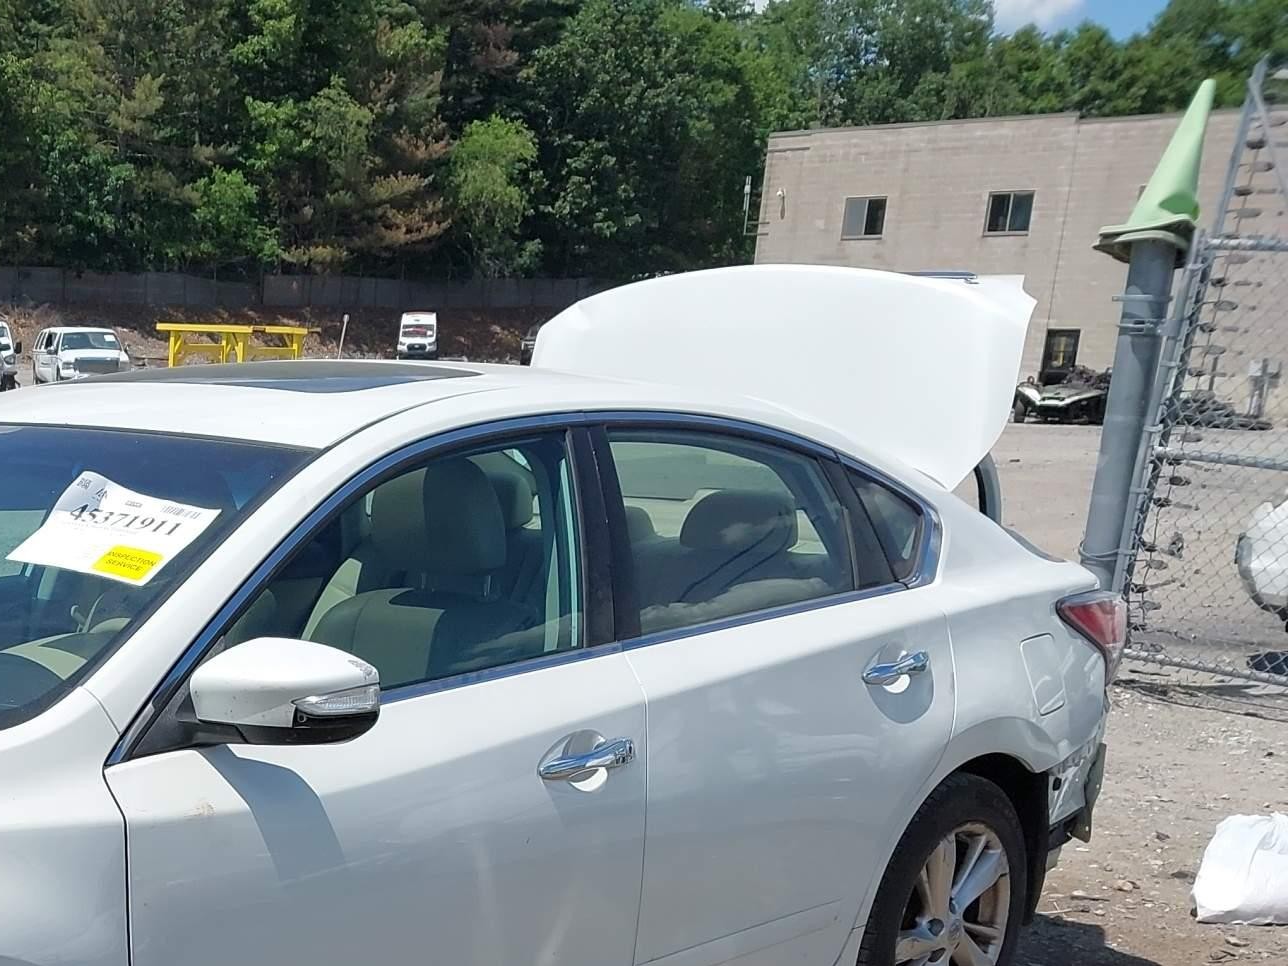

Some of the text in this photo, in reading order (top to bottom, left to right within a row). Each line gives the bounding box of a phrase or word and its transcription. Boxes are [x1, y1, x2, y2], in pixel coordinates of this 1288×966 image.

[70, 503, 182, 536] 45371911
[105, 551, 157, 567] INSPECTION
[105, 558, 144, 572] SERVICE
